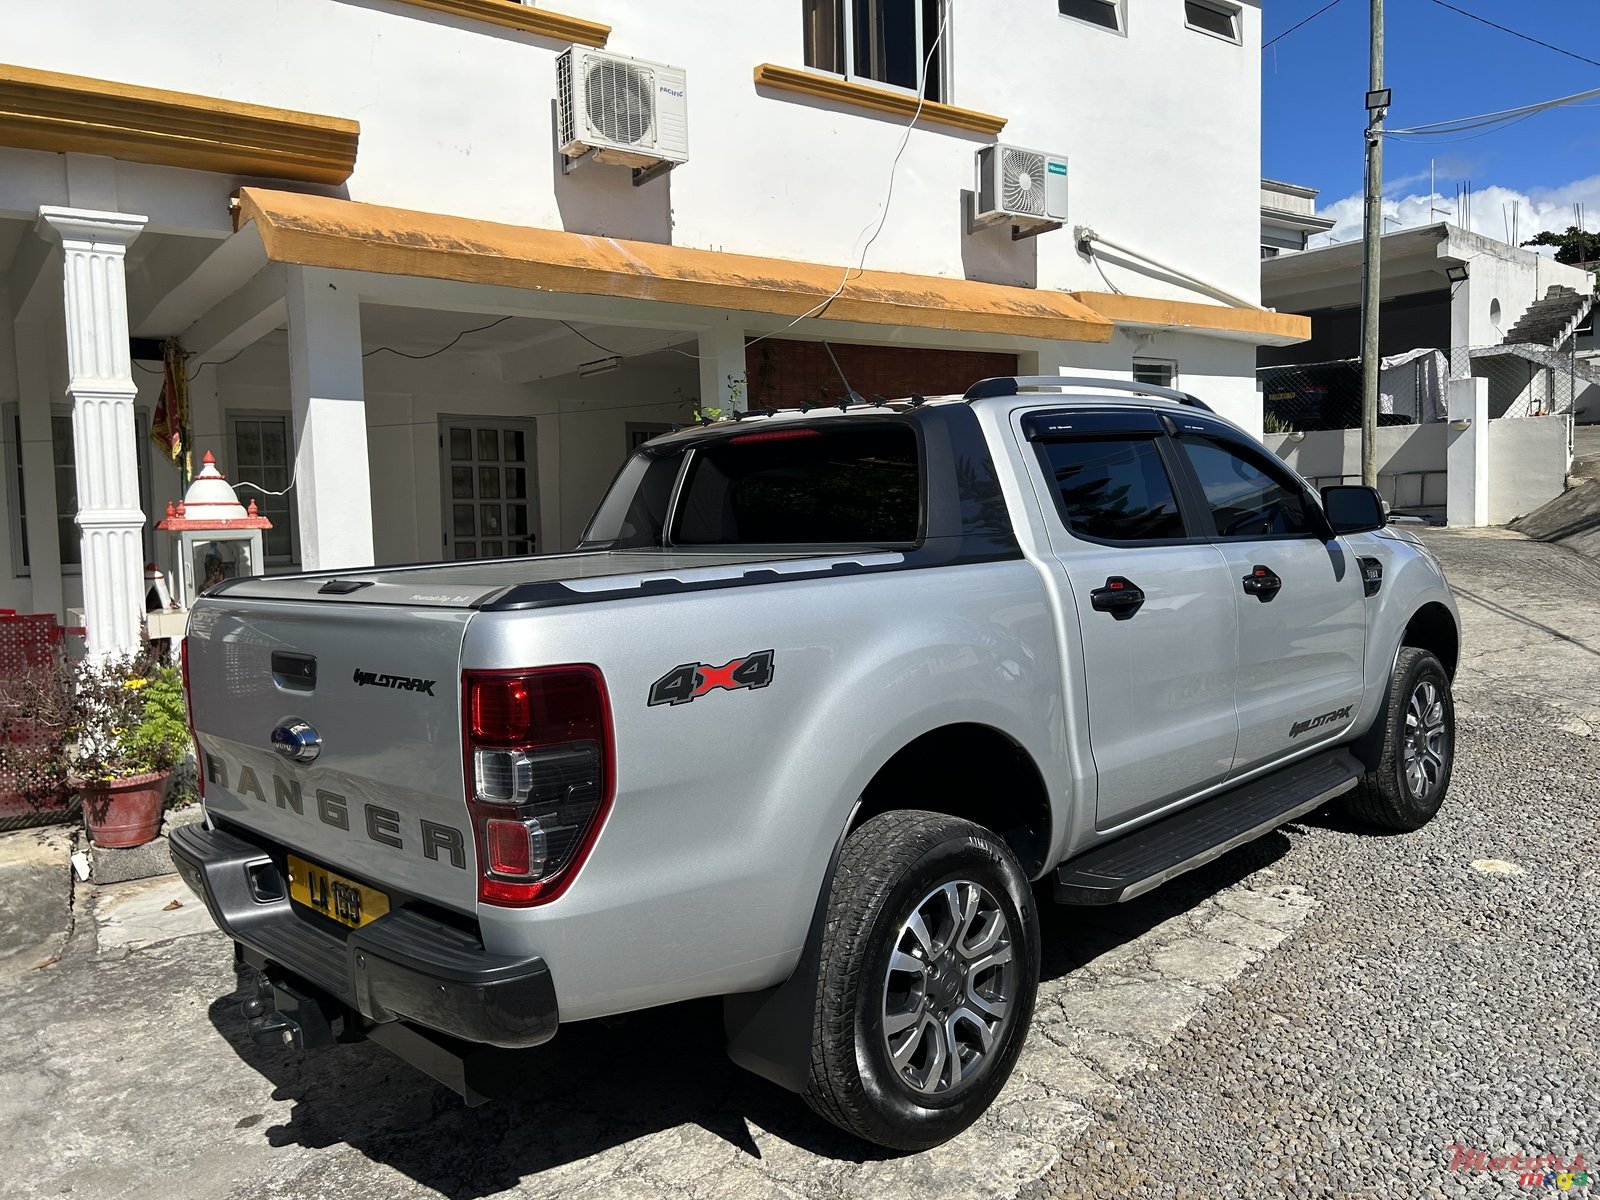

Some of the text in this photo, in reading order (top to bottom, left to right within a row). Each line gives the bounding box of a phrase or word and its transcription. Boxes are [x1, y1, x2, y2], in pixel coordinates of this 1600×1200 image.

[659, 86, 684, 98] PACIFIC
[353, 668, 437, 697] WILDTRAK
[1288, 703, 1354, 739] WILDTRAK
[205, 752, 467, 871] RANGER
